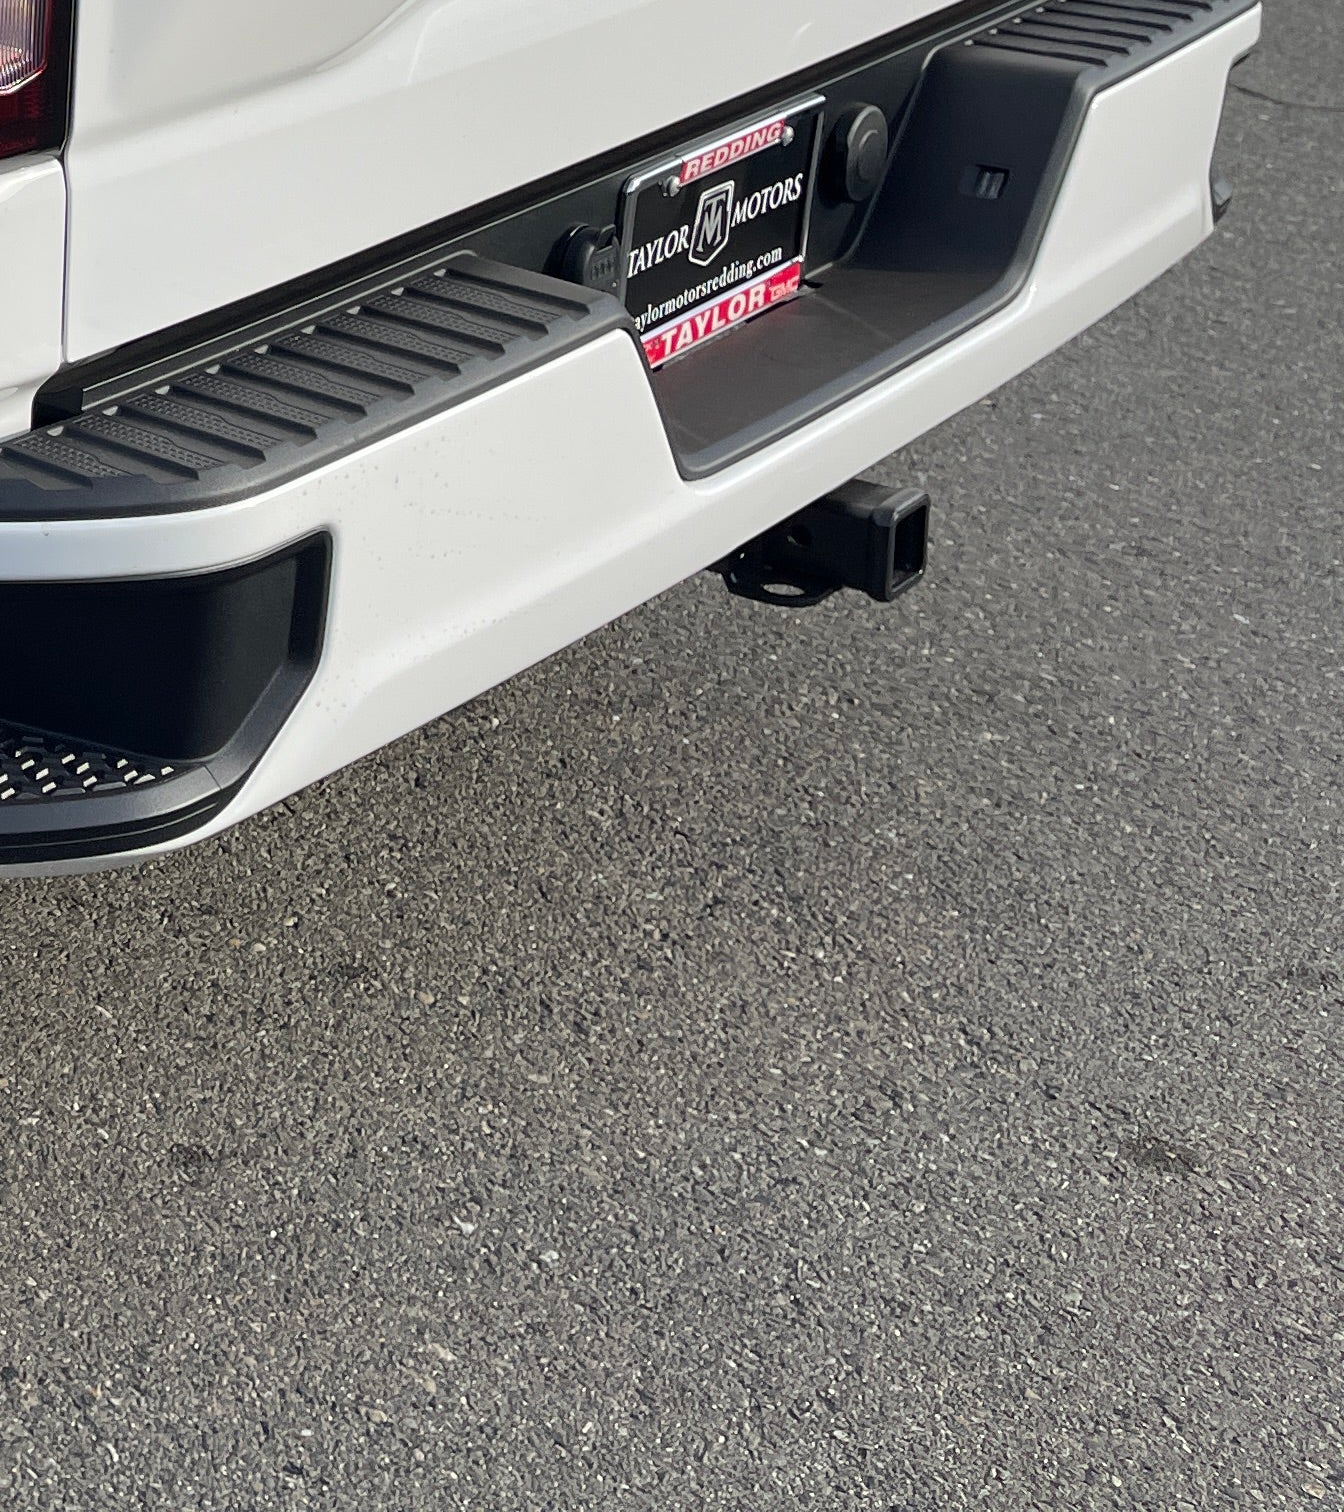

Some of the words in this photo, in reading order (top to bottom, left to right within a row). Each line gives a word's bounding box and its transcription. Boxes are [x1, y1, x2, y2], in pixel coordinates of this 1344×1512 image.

[683, 120, 786, 182] REDDING
[627, 224, 690, 278] TAYLOR
[730, 173, 804, 228] MOTORS
[634, 246, 783, 333] aylormotorsredding.com
[660, 283, 766, 356] TAYLOR
